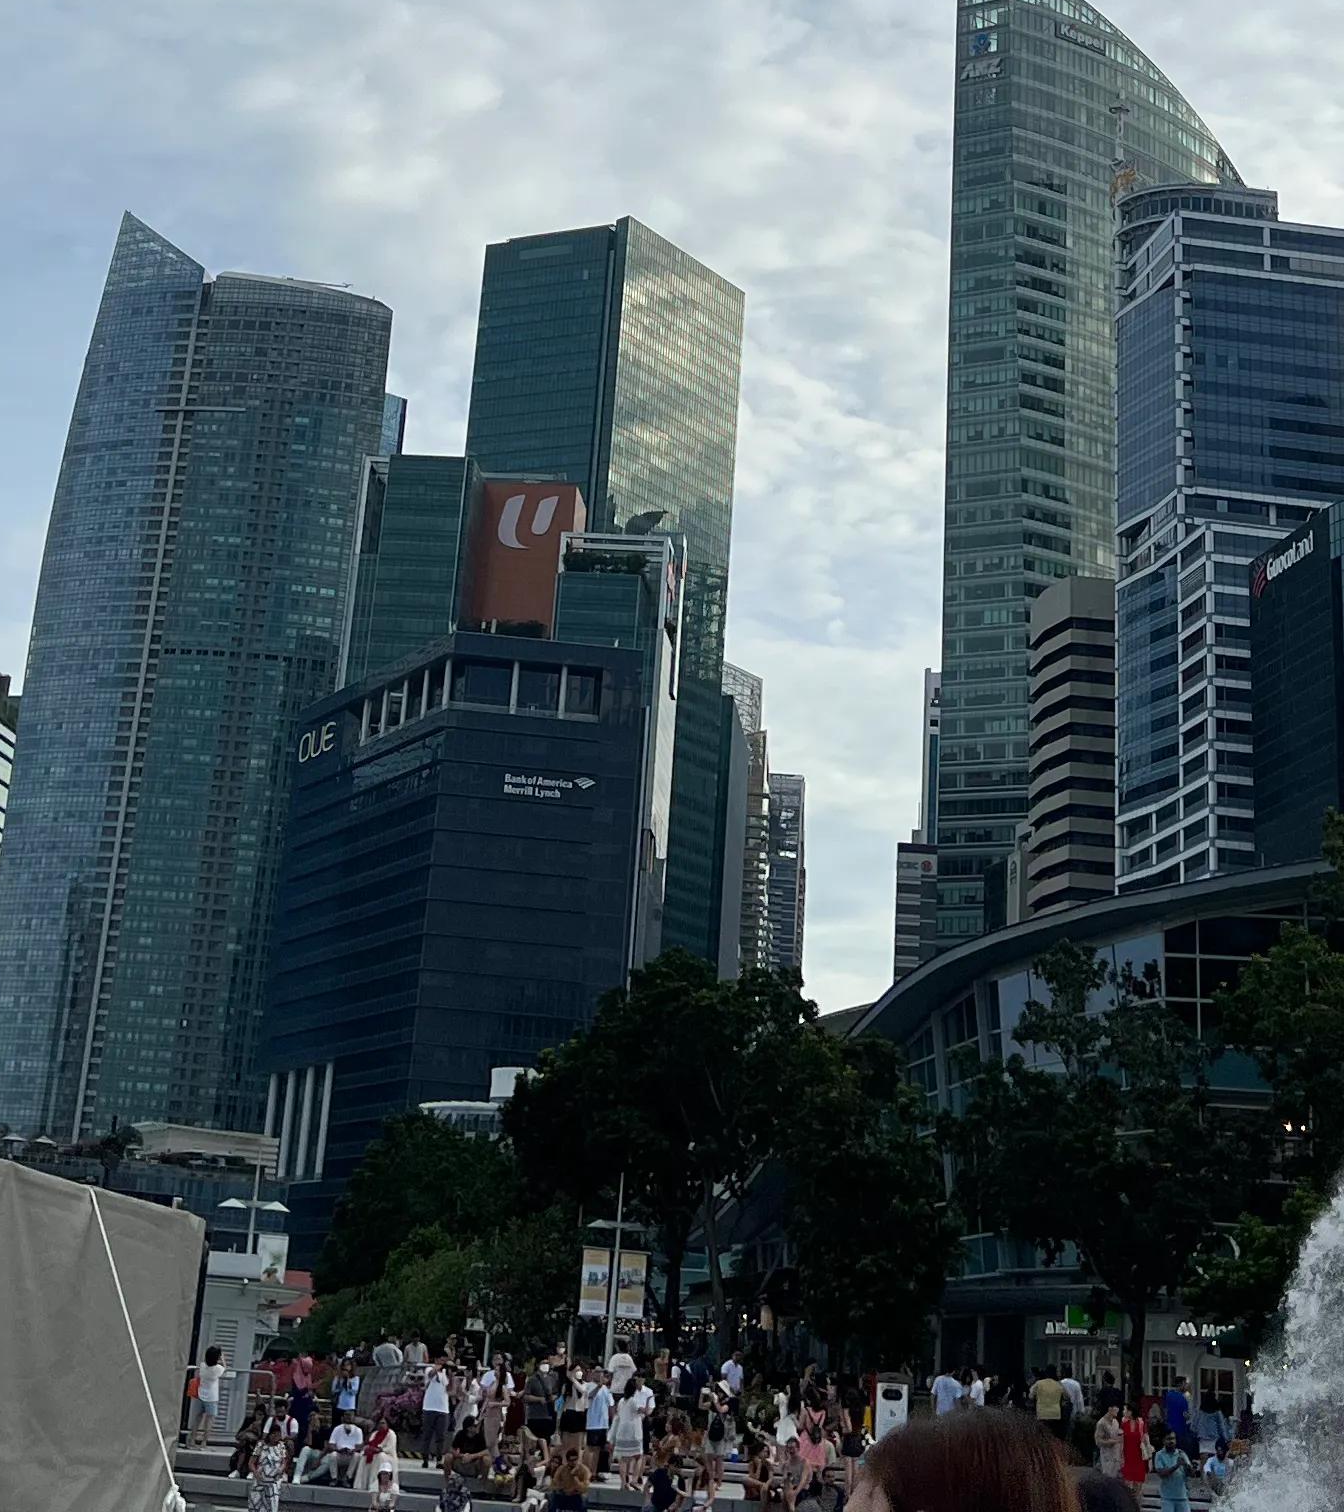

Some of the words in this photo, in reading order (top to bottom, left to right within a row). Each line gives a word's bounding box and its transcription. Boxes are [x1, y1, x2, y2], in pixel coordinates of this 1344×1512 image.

[1060, 23, 1104, 50] Keppel
[299, 721, 337, 764] OUE
[503, 784, 533, 796] Merrill
[534, 786, 561, 798] Lynch
[504, 773, 527, 785] Bank
[527, 775, 537, 785] of
[536, 775, 573, 789] America
